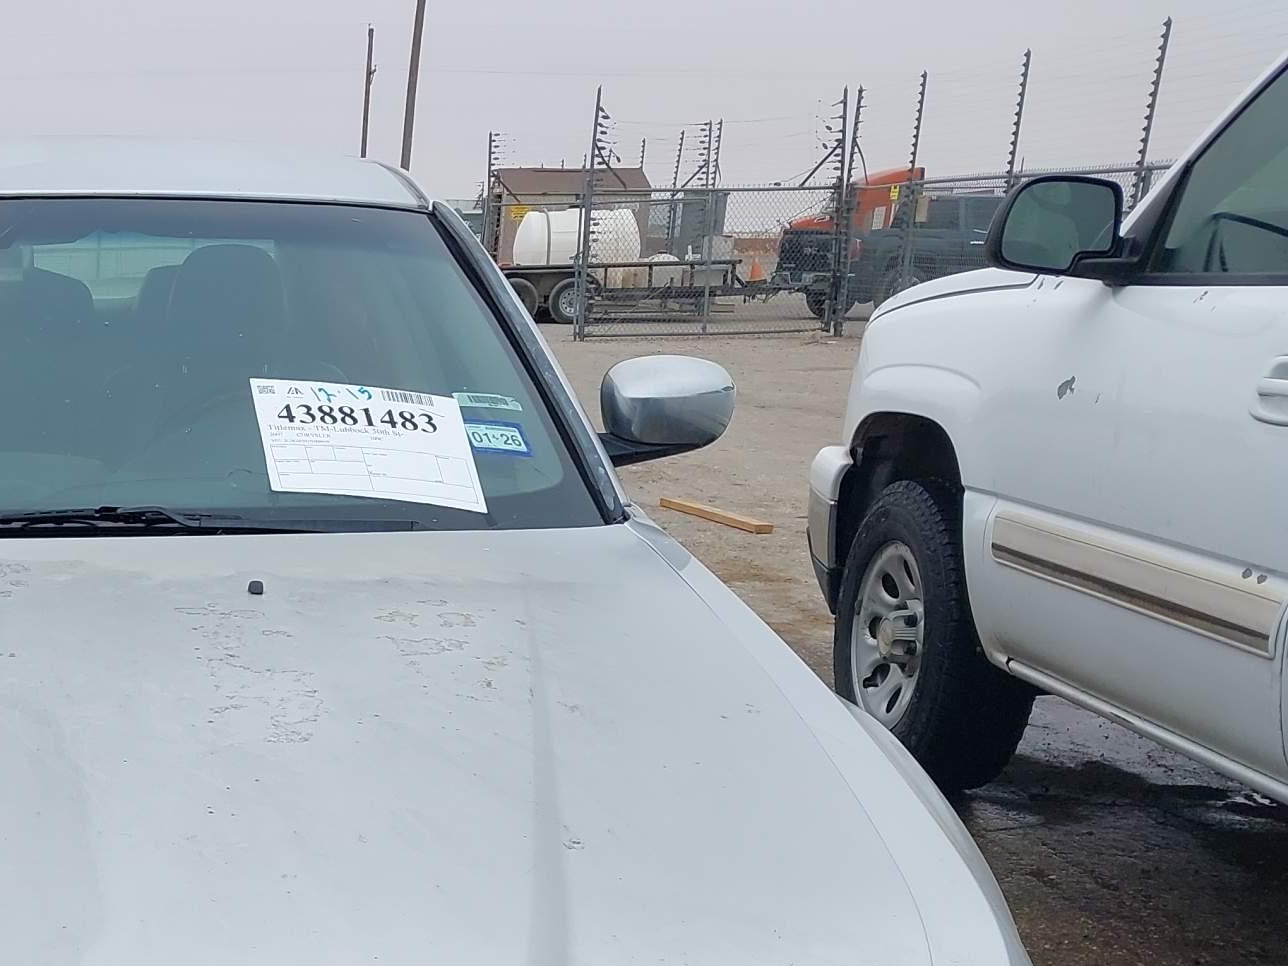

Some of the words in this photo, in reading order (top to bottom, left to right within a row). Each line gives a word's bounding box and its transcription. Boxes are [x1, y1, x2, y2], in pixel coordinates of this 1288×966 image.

[277, 403, 438, 434] 43881483
[472, 431, 493, 444] 01
[500, 433, 522, 447] 26
